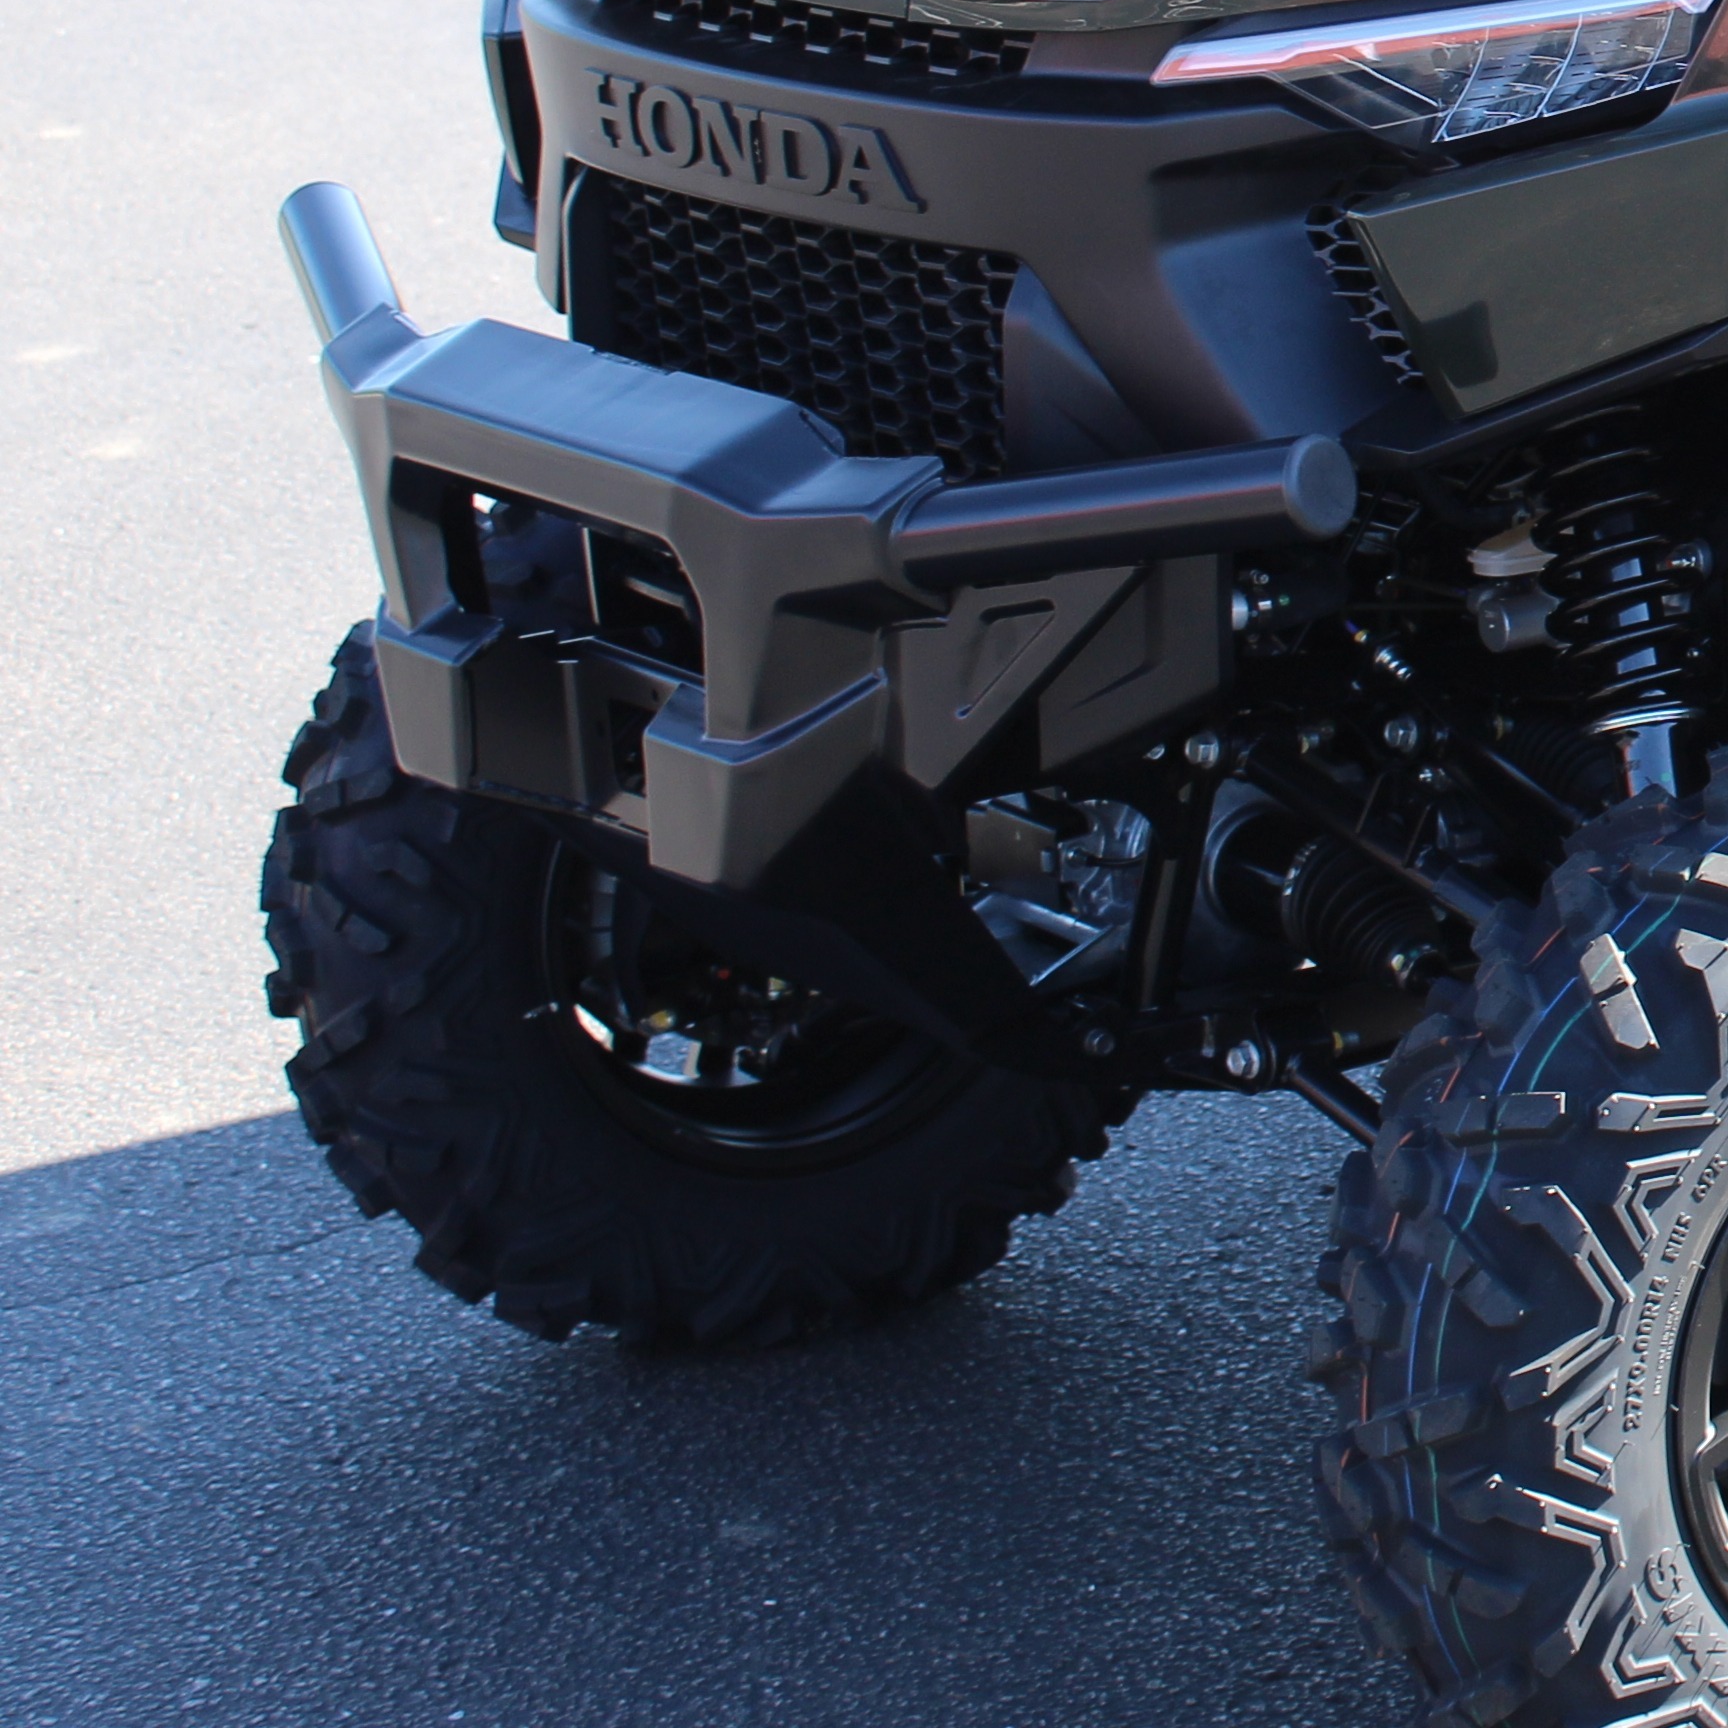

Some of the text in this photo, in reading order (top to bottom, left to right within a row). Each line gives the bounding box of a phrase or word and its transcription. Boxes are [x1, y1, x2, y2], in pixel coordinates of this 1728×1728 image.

[584, 67, 927, 214] HONDA
[1661, 1211, 1694, 1264] NHS
[1690, 1152, 1728, 1205] 6PR
